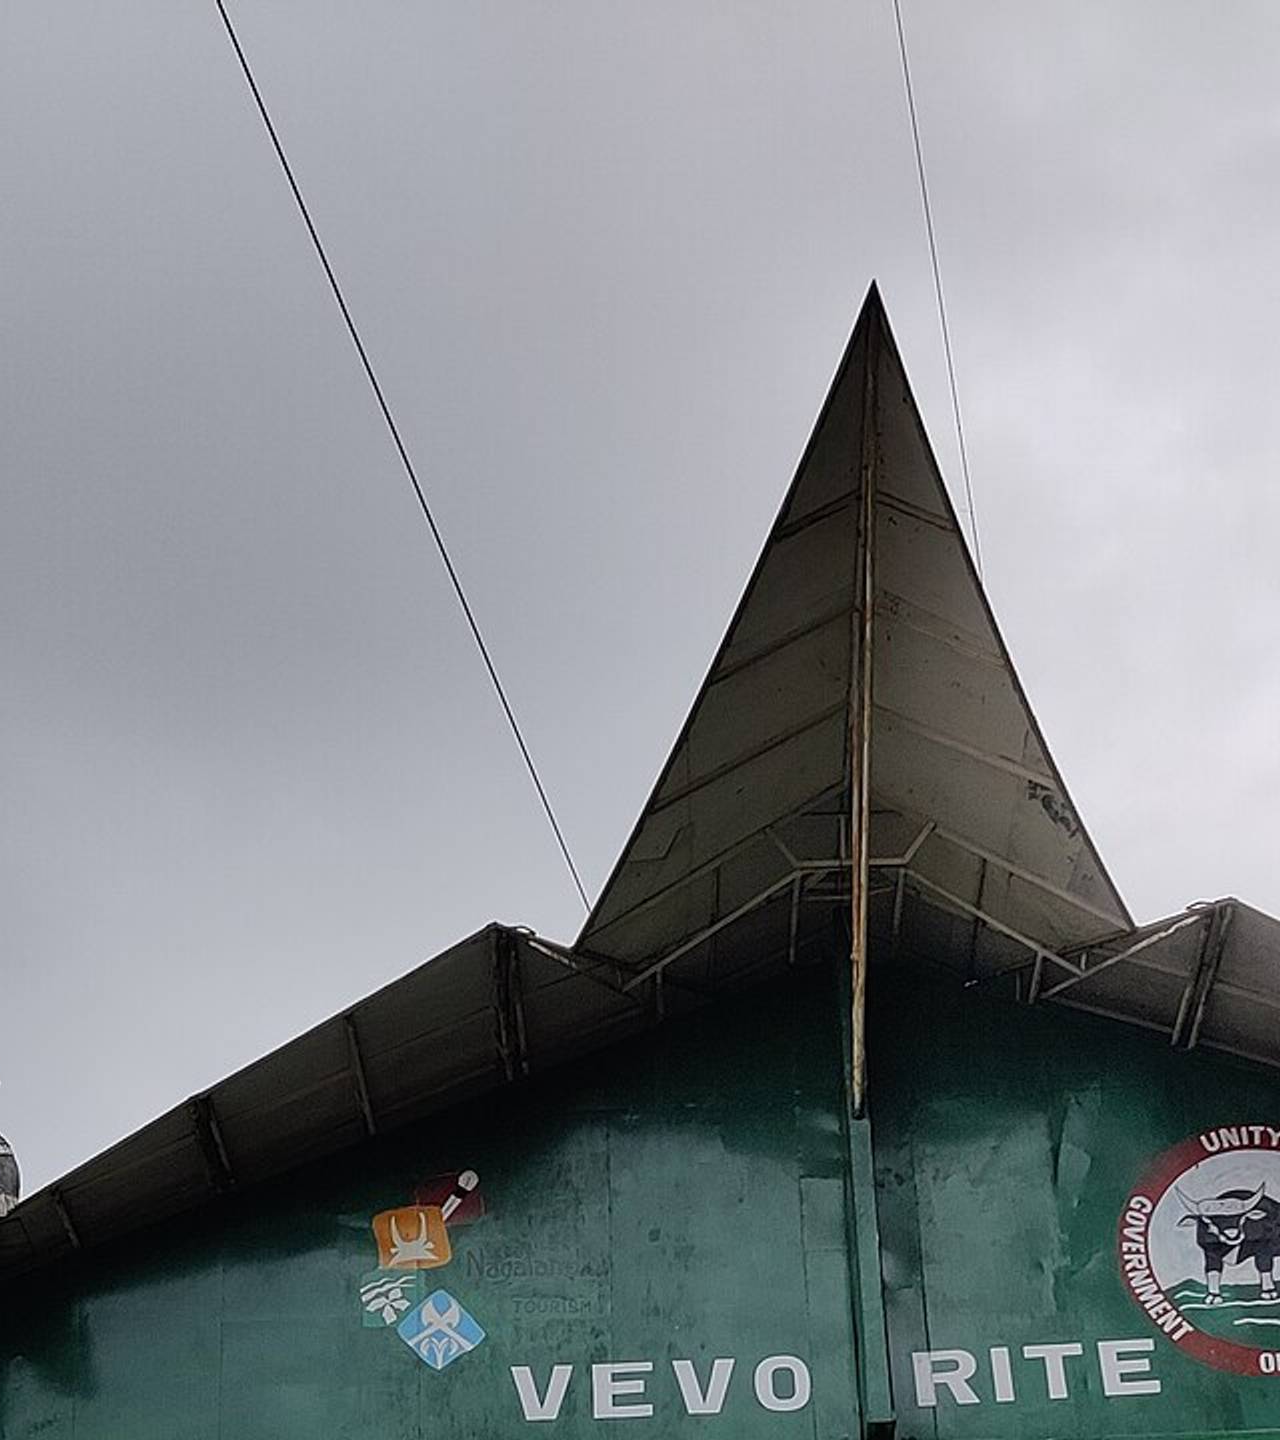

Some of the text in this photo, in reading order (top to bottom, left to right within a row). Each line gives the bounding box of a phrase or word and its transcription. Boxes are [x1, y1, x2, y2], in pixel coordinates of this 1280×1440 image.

[1121, 1195, 1195, 1342] GOVERNMENT
[510, 1338, 1163, 1422] VEVO RITE
